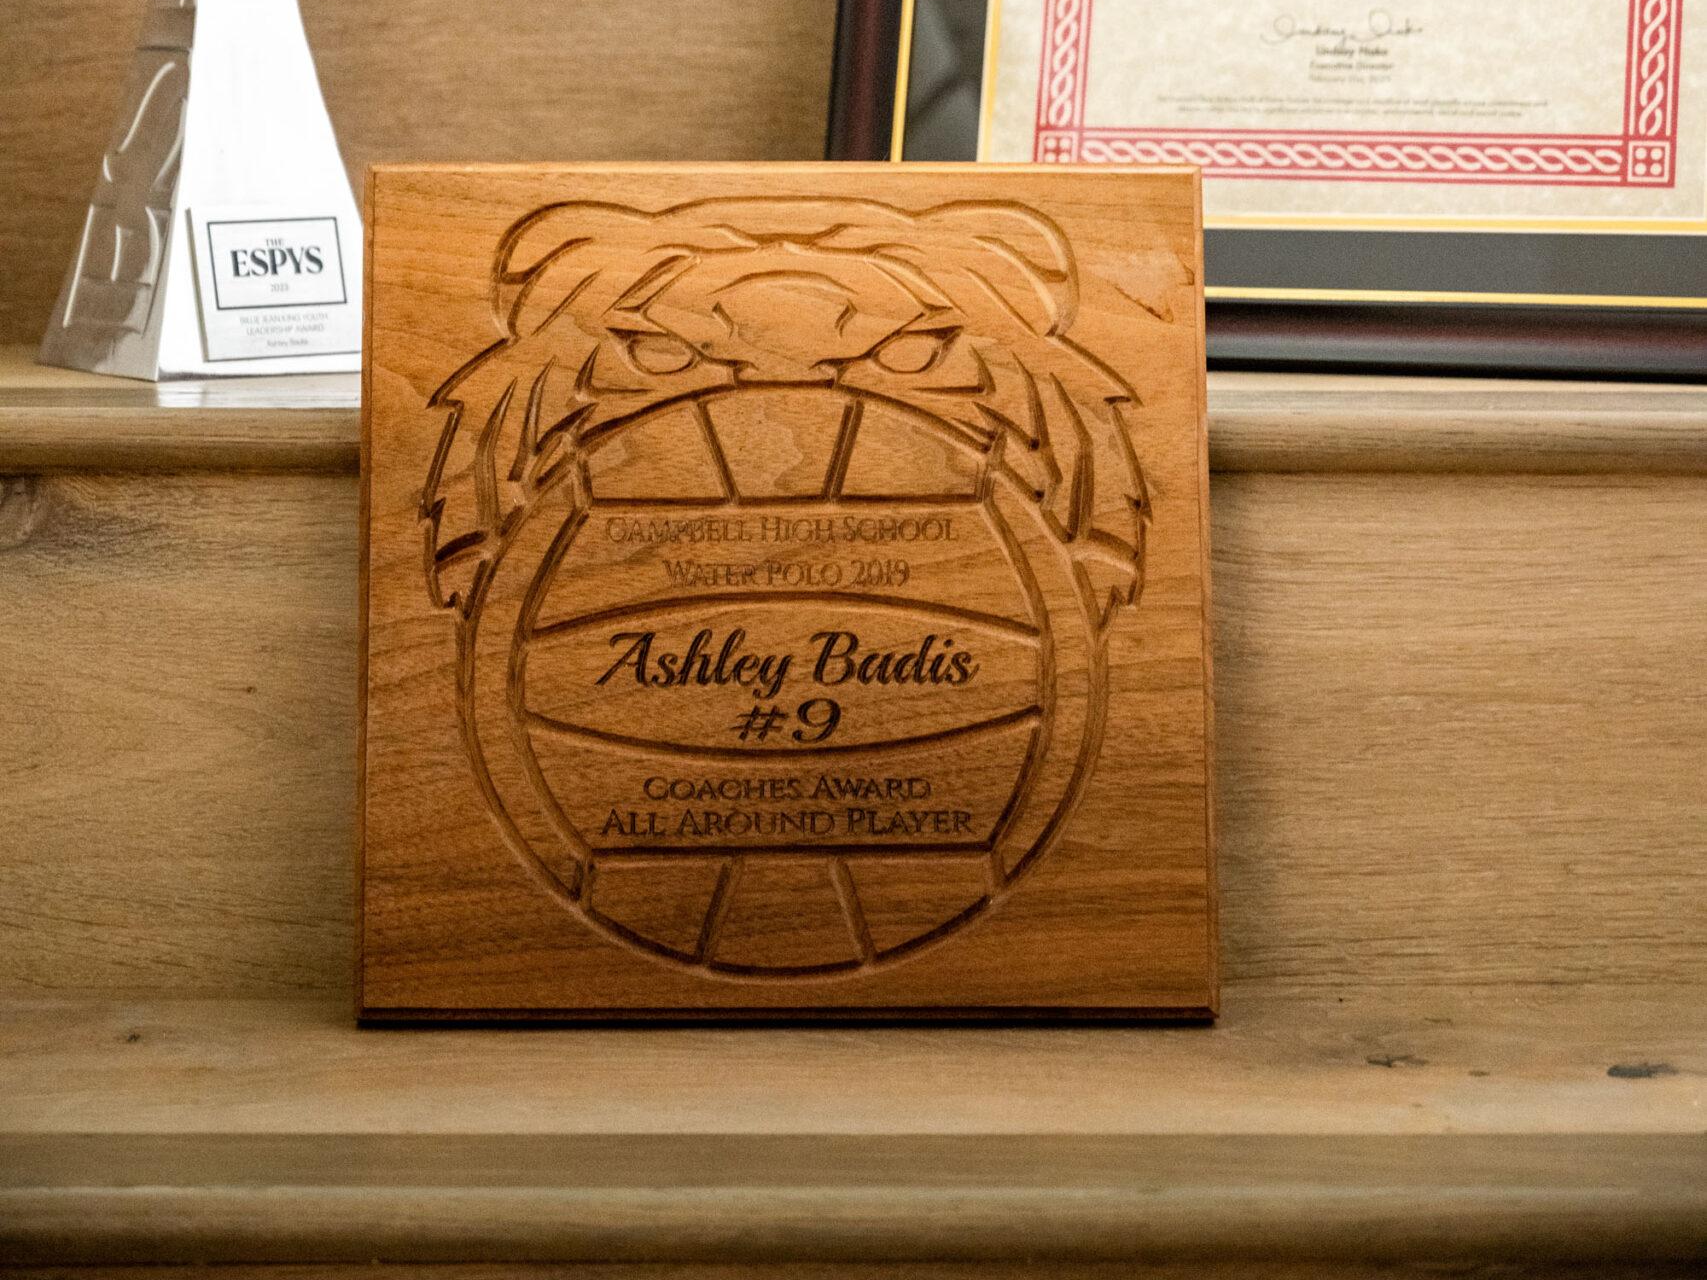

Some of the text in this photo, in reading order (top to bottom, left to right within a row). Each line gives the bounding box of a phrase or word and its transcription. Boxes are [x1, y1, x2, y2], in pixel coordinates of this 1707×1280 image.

[230, 245, 324, 278] ESPYS
[606, 517, 957, 542] CAMPBELL HIGH SCHOOL
[662, 559, 909, 586] WATER POLO 2019
[595, 629, 980, 699] Ashley Badis
[730, 699, 841, 743] #9
[643, 777, 931, 801] COACHES AWARD
[600, 809, 973, 836] ALL AROUND PLAYER
